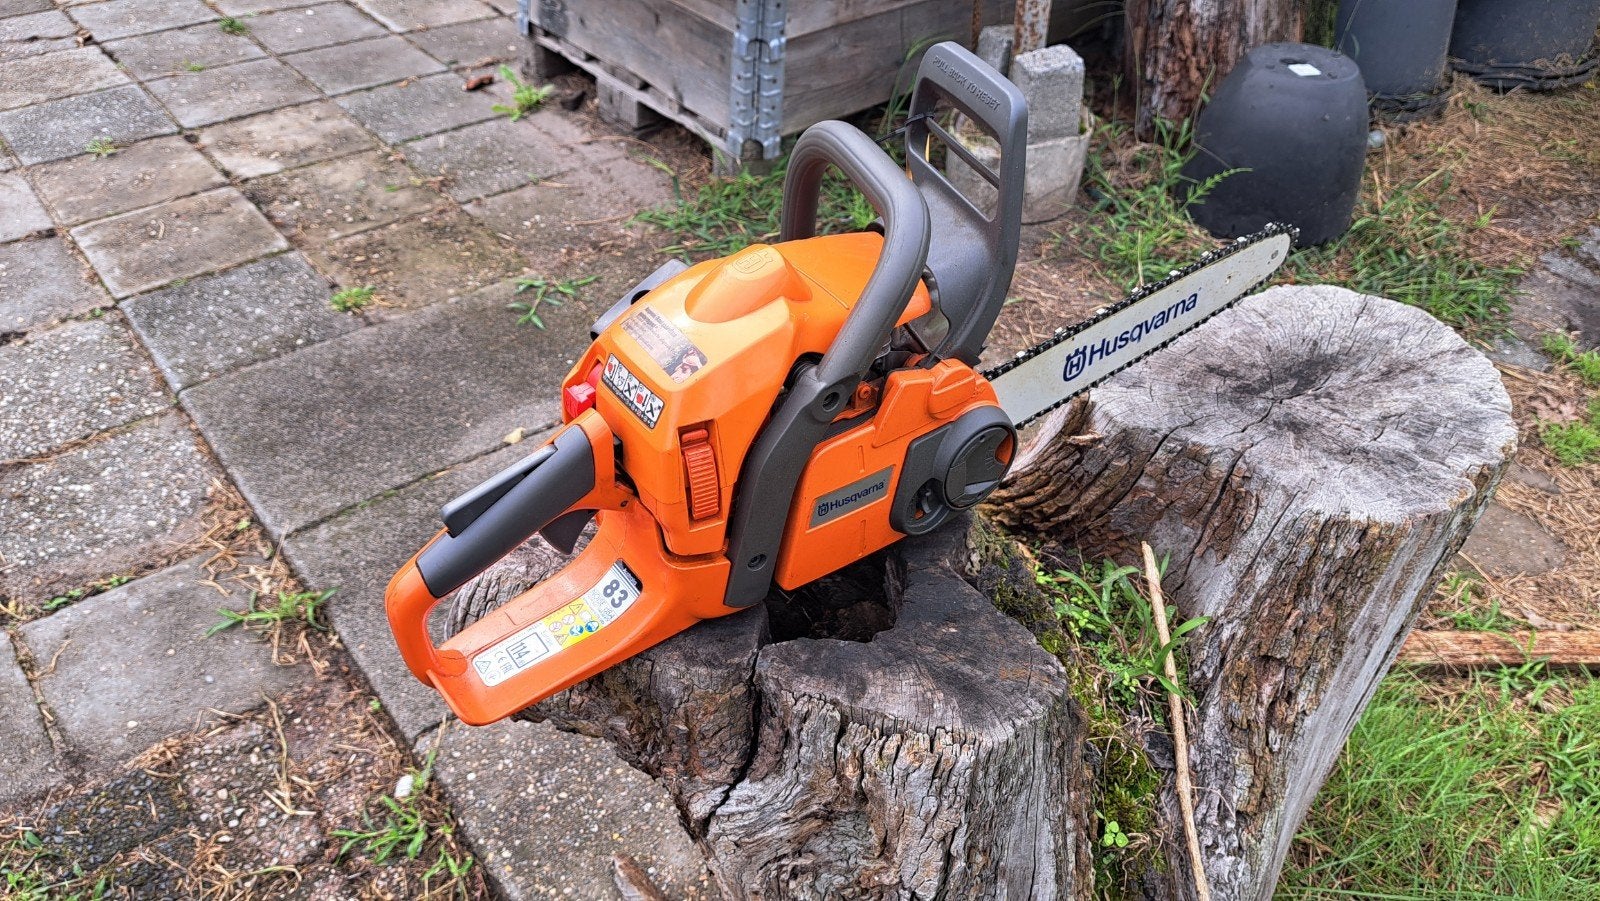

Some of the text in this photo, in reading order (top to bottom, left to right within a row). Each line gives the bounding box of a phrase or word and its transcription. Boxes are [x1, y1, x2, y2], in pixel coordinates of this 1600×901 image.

[933, 55, 1001, 110] PULL BACK TO RESET
[1088, 293, 1198, 366] Husqvarna
[830, 481, 884, 510] Husqvarna
[603, 579, 628, 608] 83
[510, 642, 531, 660] 114
